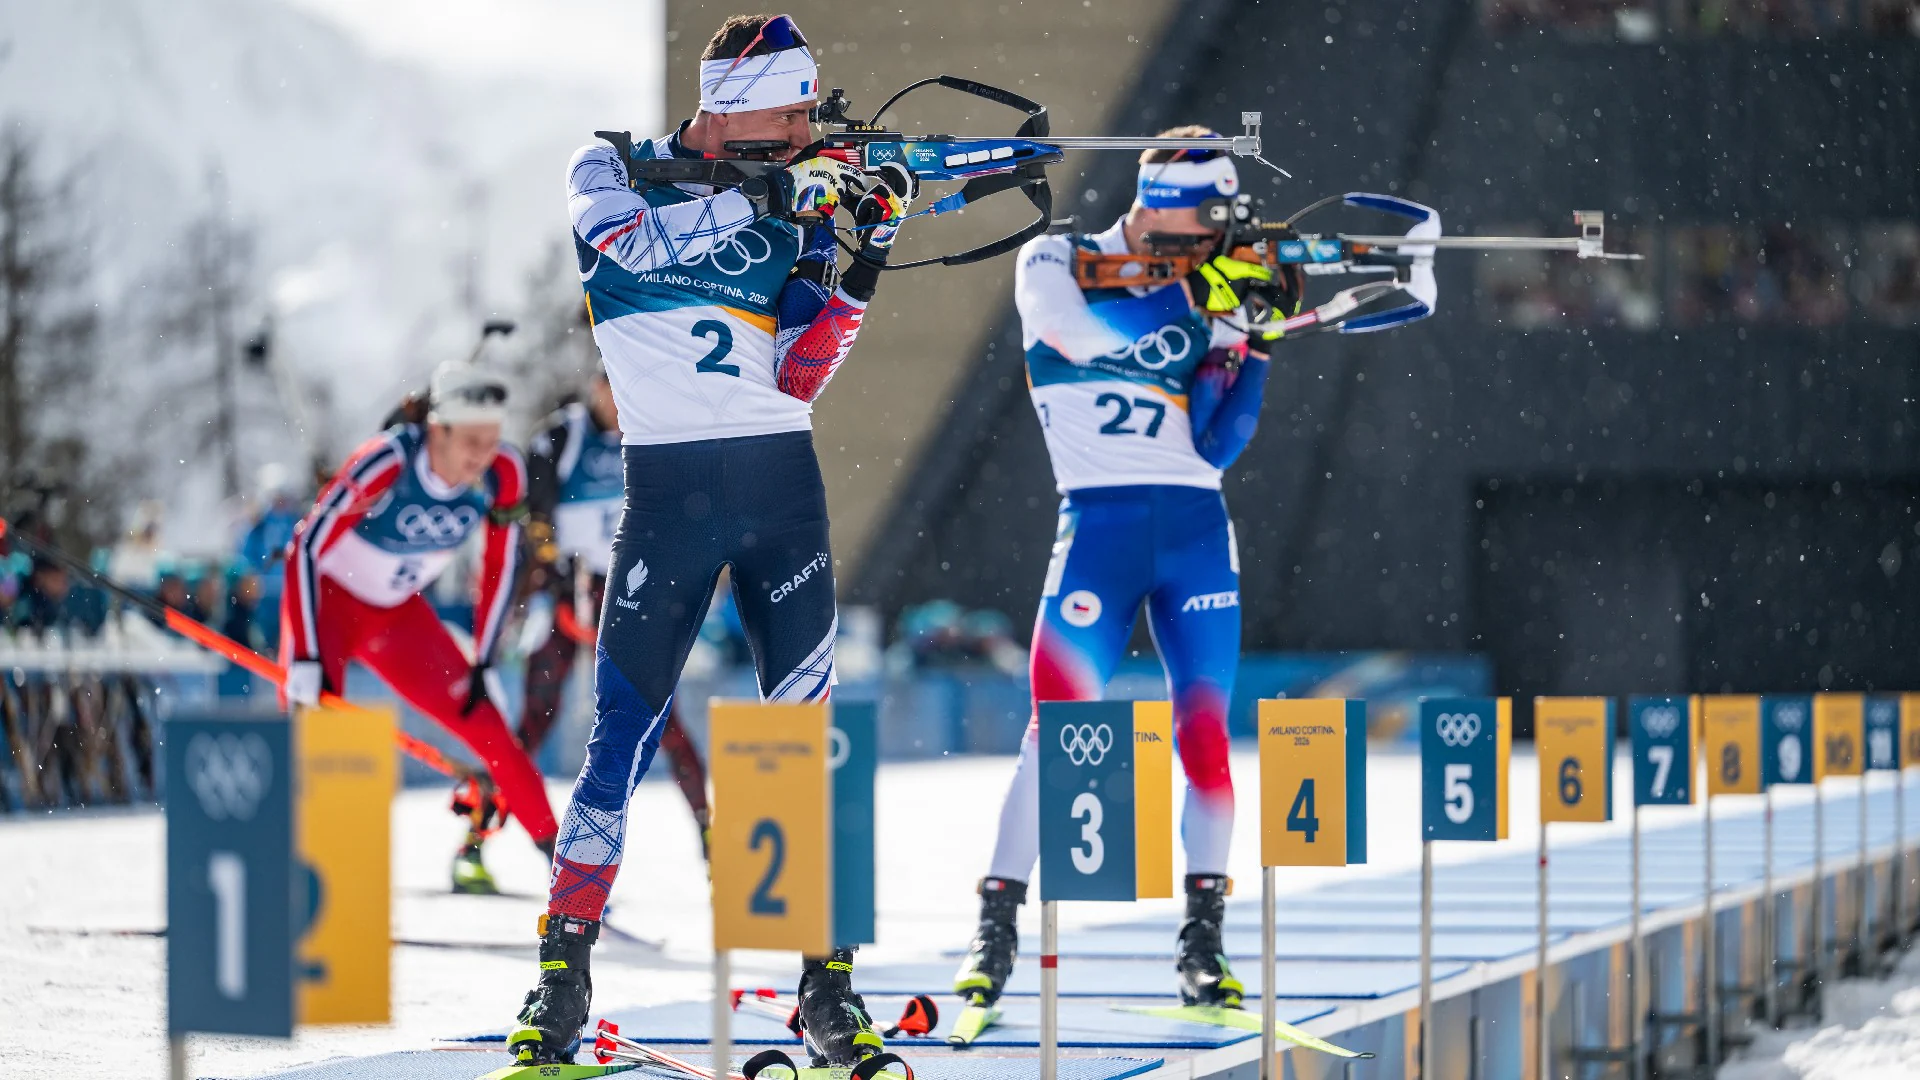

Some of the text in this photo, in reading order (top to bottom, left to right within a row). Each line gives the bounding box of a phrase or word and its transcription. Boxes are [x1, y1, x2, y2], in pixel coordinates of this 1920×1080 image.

[638, 273, 769, 305] MILANO CORTINA 2026
[691, 319, 740, 377] 2
[1094, 391, 1166, 438] 27
[615, 596, 641, 611] FRANCE
[770, 558, 819, 603] CRAFT
[1181, 590, 1240, 613] ATEX
[1134, 732, 1162, 743] TINA
[1268, 726, 1335, 735] MILANO CORTINA
[1294, 737, 1310, 746] 2026
[1558, 756, 1583, 808] 6
[1648, 745, 1674, 798] 7
[1722, 742, 1741, 787] 8
[1286, 778, 1319, 843] 4
[1443, 763, 1474, 824] 5
[1070, 792, 1105, 875] 3
[748, 817, 787, 917] 2
[207, 854, 247, 997] 1
[539, 1066, 561, 1077] FISCHER
